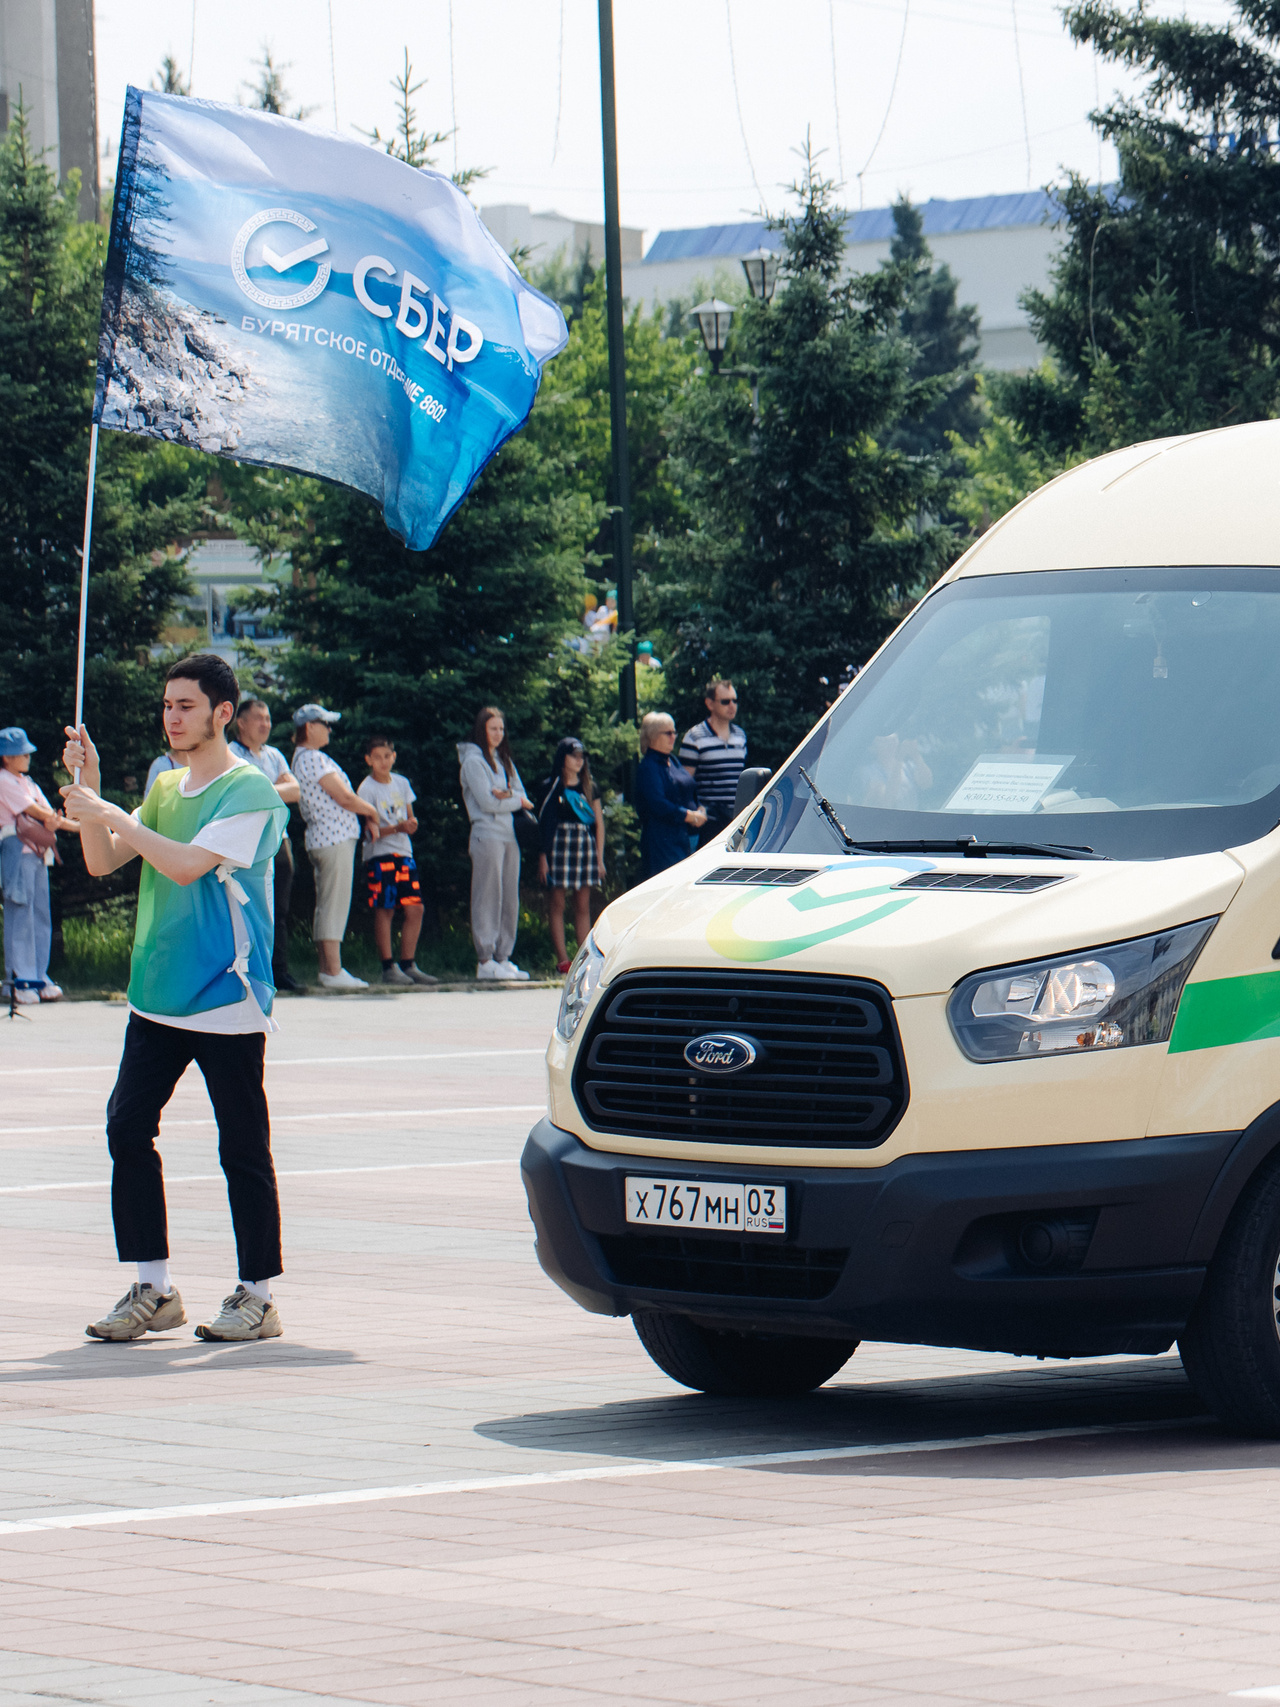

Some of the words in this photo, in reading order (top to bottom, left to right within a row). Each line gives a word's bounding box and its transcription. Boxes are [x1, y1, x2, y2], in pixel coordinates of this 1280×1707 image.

[352, 254, 484, 372] СБЕР
[241, 315, 367, 361] БУРЯТСКОЕ
[419, 394, 448, 423] 8601
[695, 1040, 735, 1065] Ford
[747, 1188, 776, 1216] 03
[746, 1217, 768, 1228] RUS
